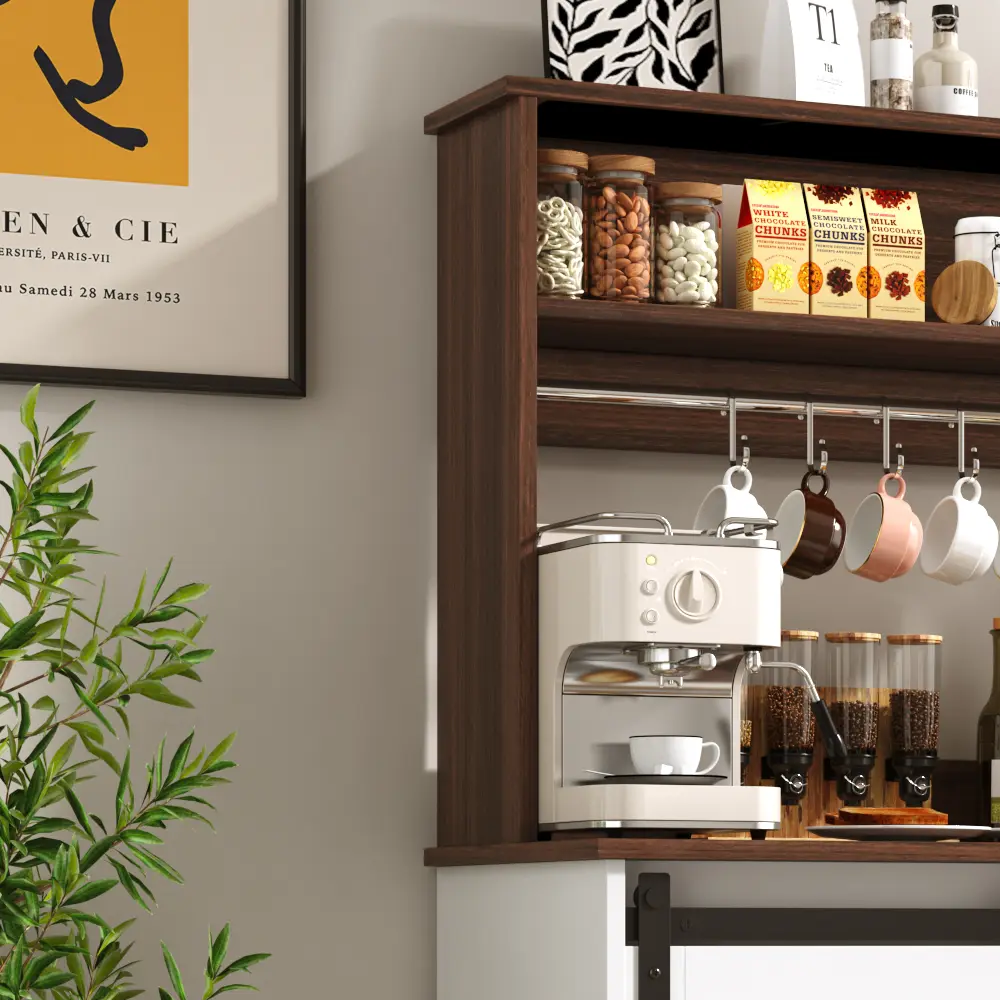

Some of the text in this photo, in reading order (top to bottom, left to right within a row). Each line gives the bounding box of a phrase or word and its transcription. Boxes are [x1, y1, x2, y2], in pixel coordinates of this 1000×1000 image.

[808, 2, 841, 46] T1
[752, 209, 789, 218] WHITE
[811, 214, 863, 224] SEMISWEET
[754, 217, 807, 227] CHOCOLATE
[813, 221, 865, 231] CHOCOLATE
[870, 217, 897, 226] MILK
[72, 215, 92, 238] &
[115, 218, 178, 244] CIE
[755, 225, 807, 238] CHUNKS
[814, 229, 865, 242] CHUNKS
[871, 226, 923, 236] CHOCOLATE
[872, 233, 923, 246] CHUNKS
[51, 250, 111, 263] PARIS-VII
[19, 283, 73, 297] Samedi
[80, 286, 97, 299] 28
[103, 288, 139, 302] Mars
[146, 291, 181, 304] 1953
